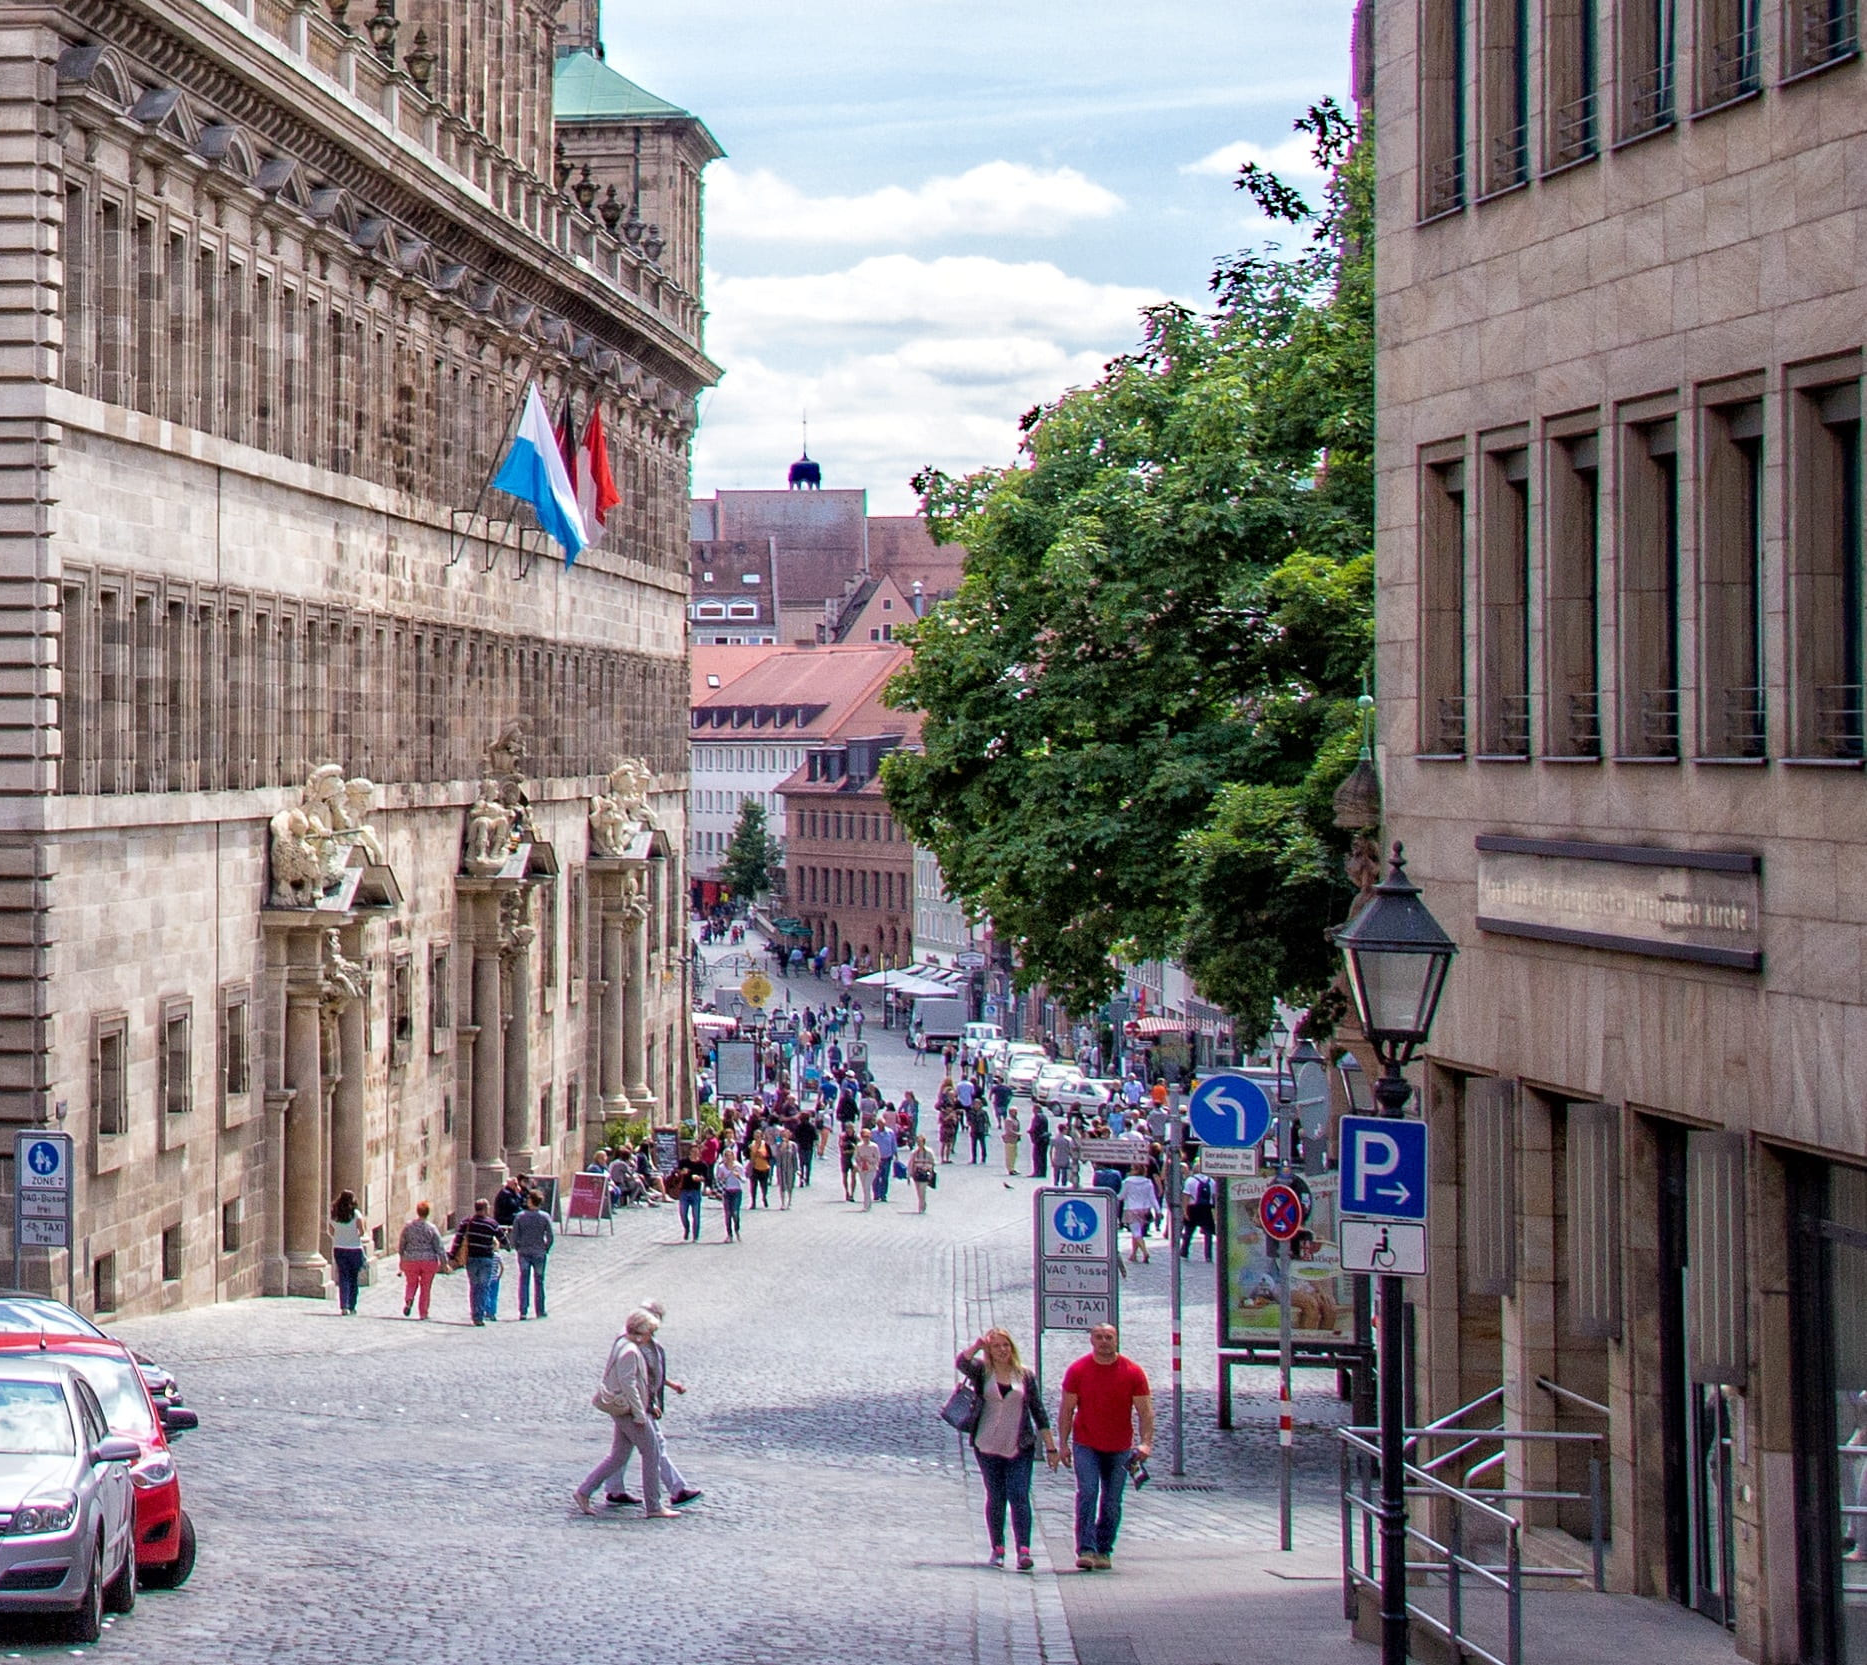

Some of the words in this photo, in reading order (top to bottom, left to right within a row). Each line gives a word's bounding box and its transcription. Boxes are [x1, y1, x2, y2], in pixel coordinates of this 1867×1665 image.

[1705, 896, 1748, 931] kirche
[1355, 1130, 1400, 1201] P
[31, 1177, 55, 1186] ZONE
[43, 1222, 64, 1232] TAXI
[35, 1233, 52, 1243] frei
[1059, 1243, 1093, 1254] ZONE
[1076, 1300, 1105, 1312] TAXI
[1066, 1314, 1088, 1325] frei
